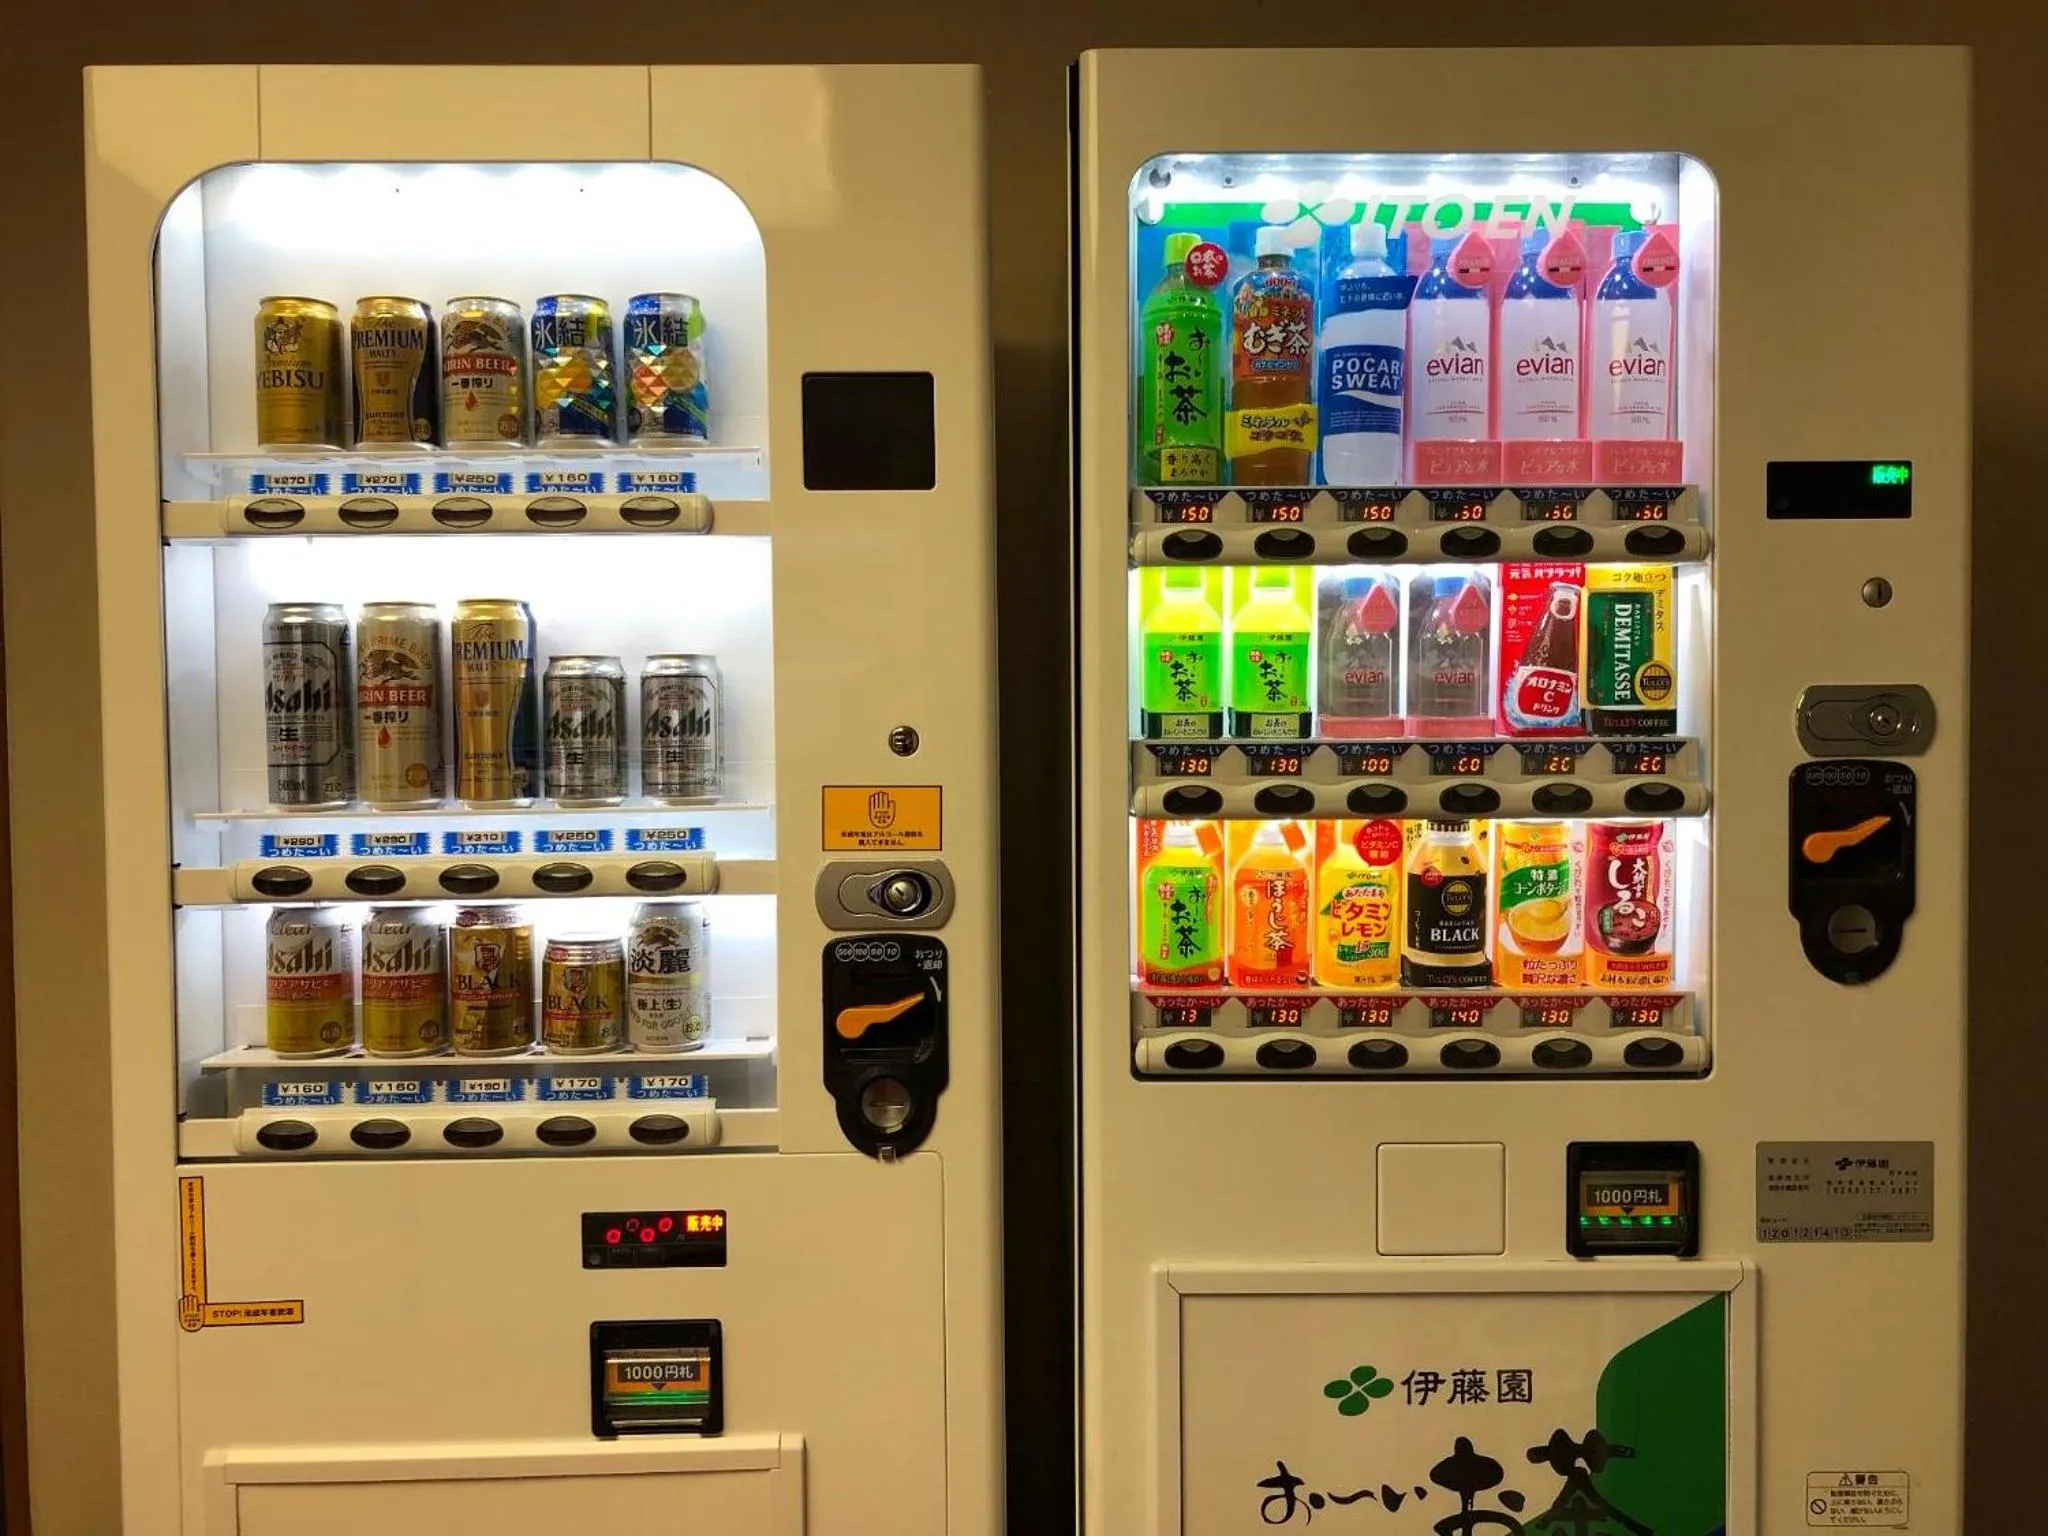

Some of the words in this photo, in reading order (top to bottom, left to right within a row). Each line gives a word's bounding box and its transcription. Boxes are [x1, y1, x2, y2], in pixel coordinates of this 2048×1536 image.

[1360, 194, 1475, 240] ITO
[1484, 194, 1576, 240] EN
[351, 329, 423, 350] PREMIUM
[534, 317, 587, 350] 氷結
[634, 316, 689, 348] 氷結
[1243, 320, 1313, 356] むぎ茶
[1426, 354, 1484, 377] evian
[1516, 353, 1575, 377] evian
[1609, 353, 1666, 377] evian
[256, 369, 324, 390] YEBISU
[450, 377, 494, 389] 一番搾り
[1331, 375, 1400, 391] SWEAT
[1614, 603, 1633, 700] DEMITASSE
[1344, 669, 1385, 685] evian
[1434, 669, 1476, 685] evian
[389, 689, 427, 703] BEER
[1543, 691, 1555, 702] C
[363, 710, 410, 724] 一番搾り
[645, 708, 711, 738] Asahi
[278, 726, 300, 742] 生
[1330, 900, 1392, 921] ビタミン
[1341, 921, 1388, 939] レモン
[1430, 927, 1480, 942] BLACK
[631, 948, 692, 975] 淡麗
[915, 949, 943, 959] おつり
[1594, 1189, 1663, 1204] 1000円札
[687, 1214, 724, 1233] 販売中
[625, 1365, 694, 1380] 1000円札
[1401, 1368, 1534, 1406] 伊藤園
